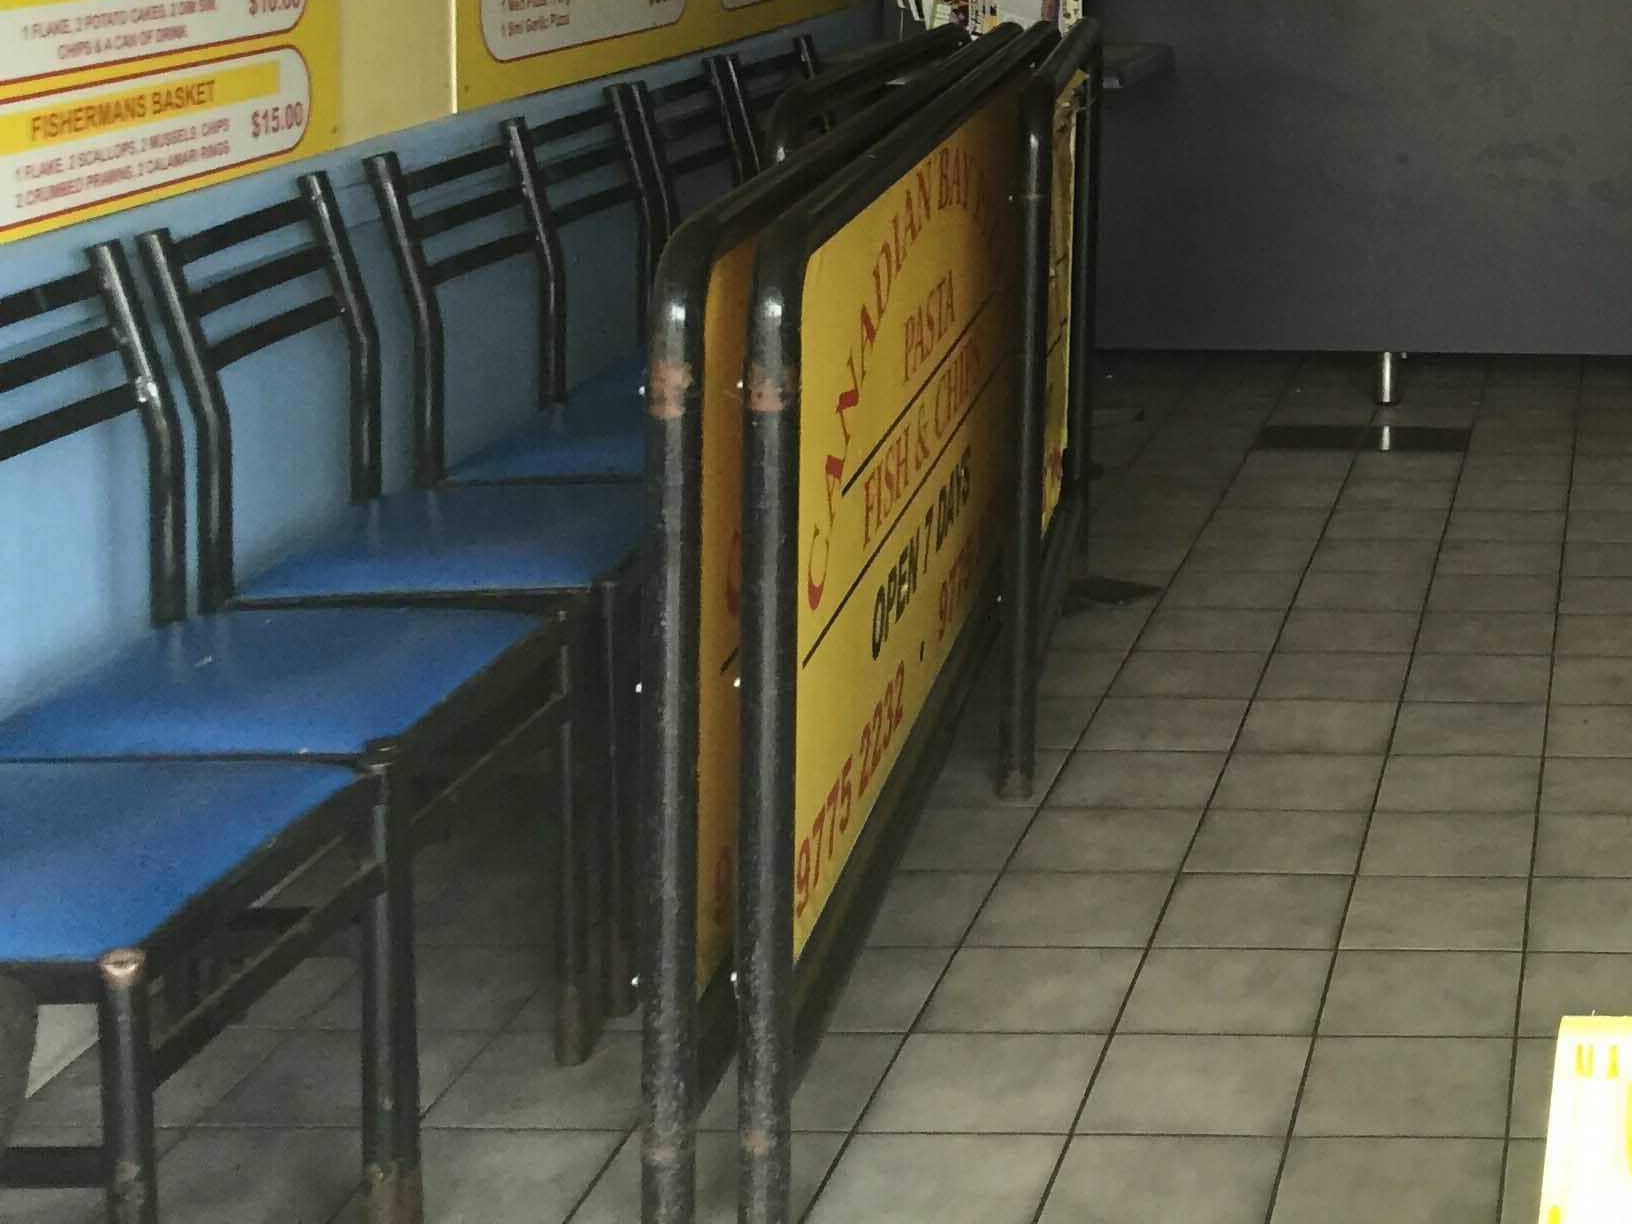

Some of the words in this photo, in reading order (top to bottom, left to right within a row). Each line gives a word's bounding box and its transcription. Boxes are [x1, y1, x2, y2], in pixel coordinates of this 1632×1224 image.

[31, 93, 147, 142] FISHERMANS
[152, 79, 216, 115] BASKET
[251, 101, 304, 139] $15.00
[807, 159, 931, 612] CANADIAN
[903, 269, 956, 384] PASTA
[863, 421, 911, 552] FISH
[914, 402, 931, 473] &
[872, 526, 921, 662] OPEN
[923, 504, 935, 577] 7
[936, 444, 971, 554] DAYS
[797, 753, 853, 919] 9775
[858, 660, 905, 799] 2232
